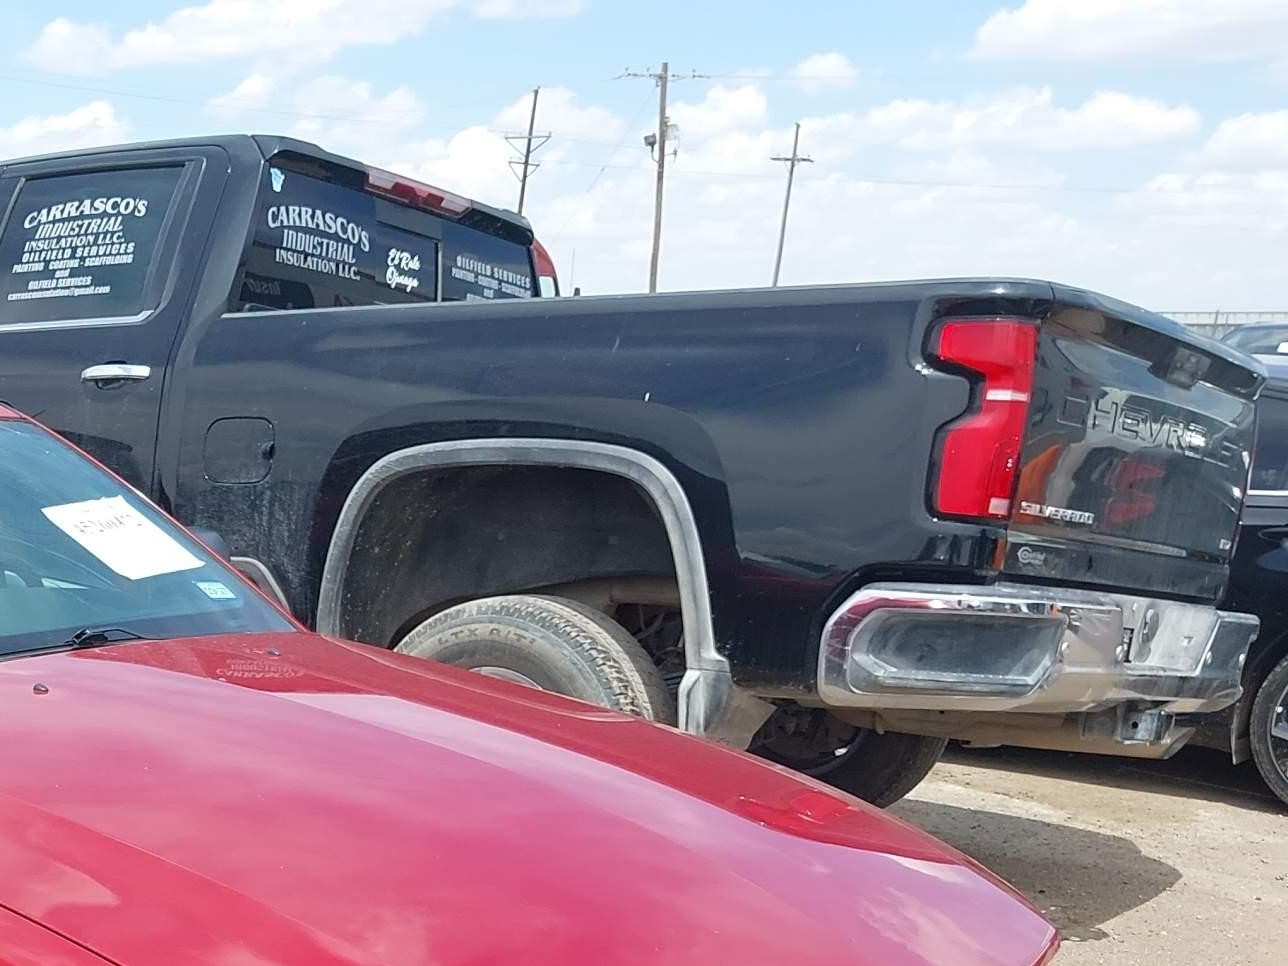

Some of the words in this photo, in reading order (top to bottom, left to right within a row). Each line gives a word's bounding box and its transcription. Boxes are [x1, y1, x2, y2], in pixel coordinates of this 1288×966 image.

[24, 197, 148, 229] CARRASCO'S
[35, 216, 123, 239] INDUSTRIAL
[267, 205, 370, 252] CARRASCO'S
[22, 248, 72, 263] OILFIELD
[75, 243, 135, 258] SERVICES
[23, 234, 94, 252] INSULATION
[97, 232, 125, 244] LLC.
[282, 229, 356, 264] INDUSTRIAL
[275, 248, 337, 275] INSULATION
[338, 262, 361, 280] LLC.
[456, 255, 491, 276] OILFIELD
[493, 267, 530, 289] SERVICES
[1019, 501, 1094, 524] SILVERADO
